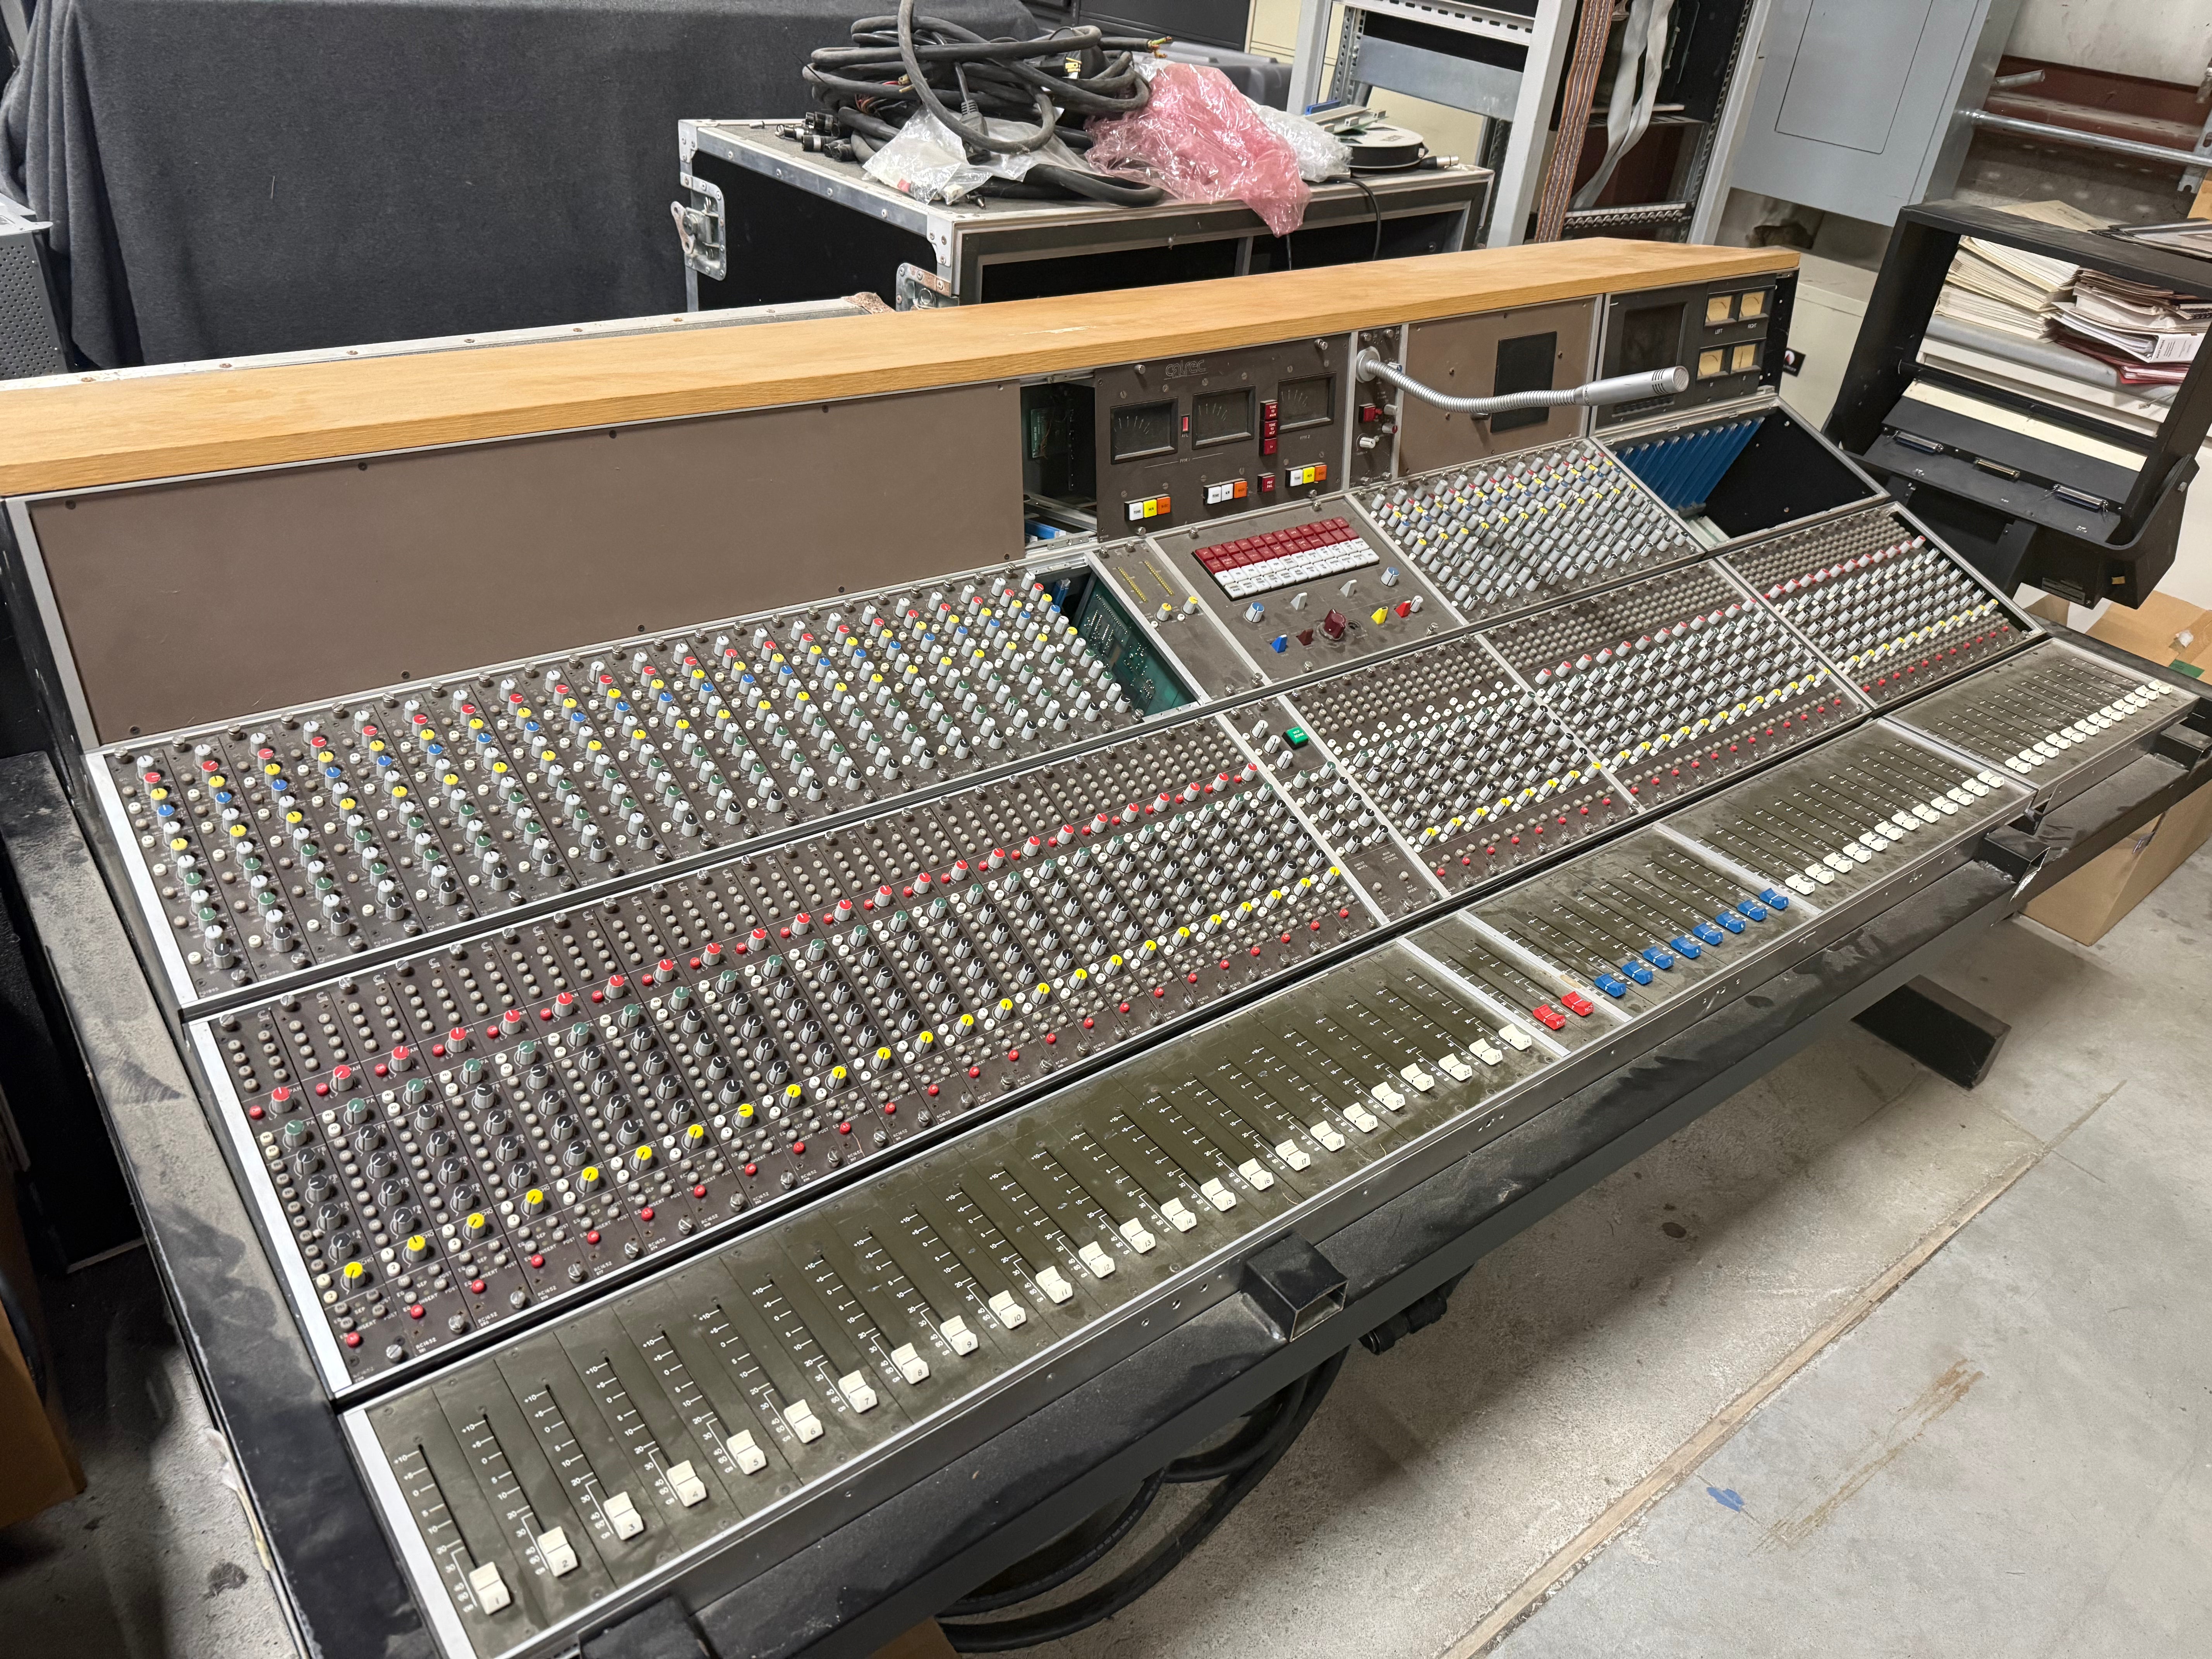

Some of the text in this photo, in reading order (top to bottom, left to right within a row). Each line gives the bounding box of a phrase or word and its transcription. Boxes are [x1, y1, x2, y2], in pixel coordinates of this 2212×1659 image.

[648, 1199, 665, 1208] INSERT
[419, 1293, 438, 1305] INSERT
[1014, 1314, 1021, 1322] 10
[634, 1446, 644, 1454] 20
[644, 1462, 654, 1470] 30
[570, 1477, 581, 1486] 20
[497, 1492, 507, 1500] 10
[581, 1495, 591, 1503] 30
[507, 1511, 517, 1520] 20
[591, 1512, 600, 1520] 40
[428, 1526, 438, 1534] 10
[515, 1528, 526, 1537] 30
[562, 1560, 568, 1568] 2
